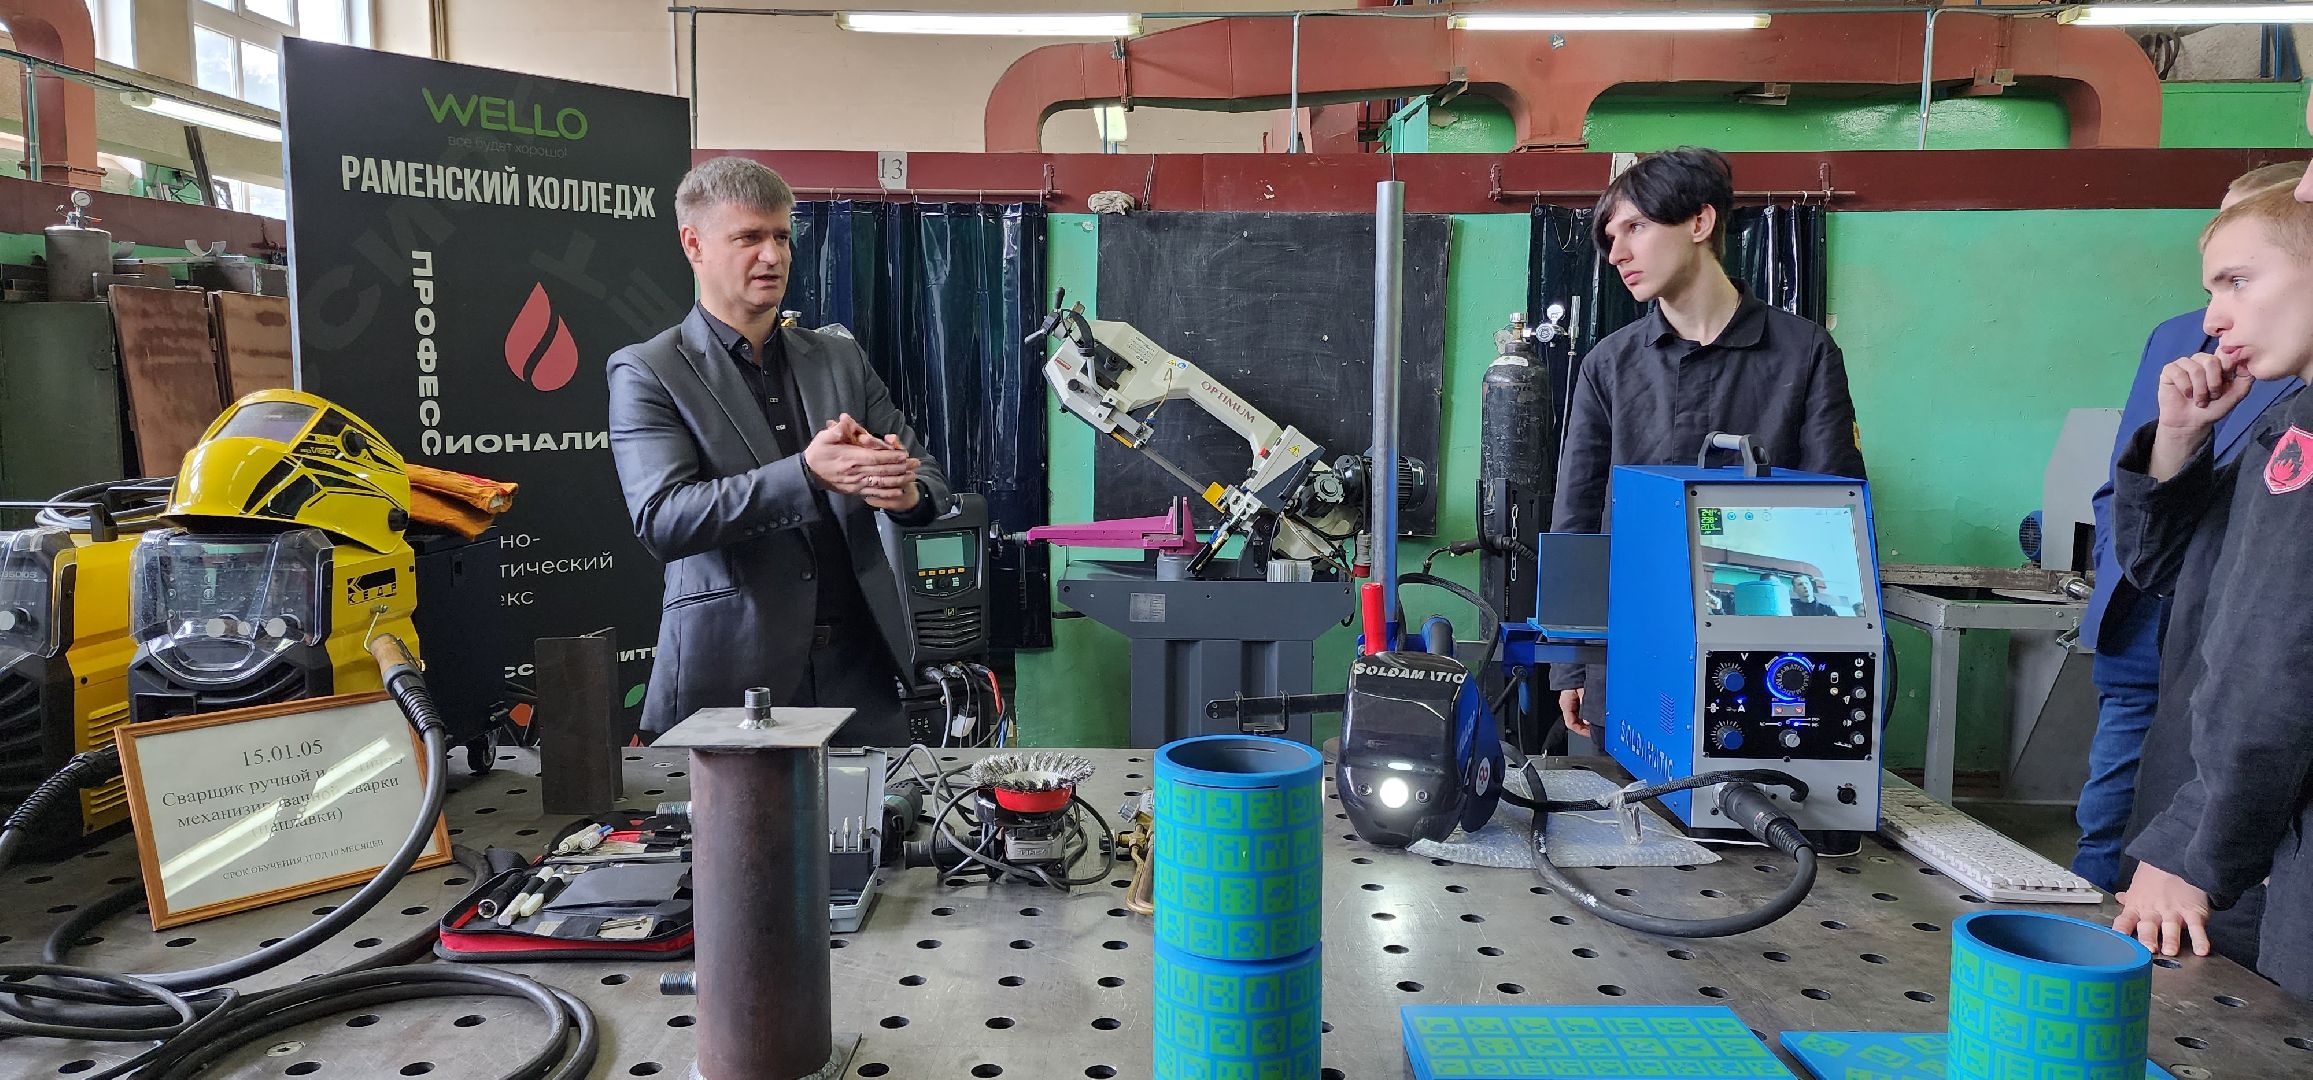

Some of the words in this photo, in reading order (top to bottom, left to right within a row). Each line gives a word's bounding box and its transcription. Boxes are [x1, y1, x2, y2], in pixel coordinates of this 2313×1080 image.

[421, 88, 588, 140] WELLO
[341, 154, 520, 206] РАМЕНСКИЙ
[528, 174, 657, 220] КОЛЛЕДЖ
[879, 157, 904, 180] 13
[1201, 380, 1255, 423] OPTIMUM
[347, 582, 397, 605] КЕДР
[243, 739, 323, 767] 15.01.05
[162, 784, 246, 807] Сварщик
[249, 768, 311, 795] ручной
[222, 867, 249, 880] СРОК
[251, 857, 302, 874] ОБУЧЕНИЯ
[340, 839, 384, 854] МЕСЯЦЕВ
